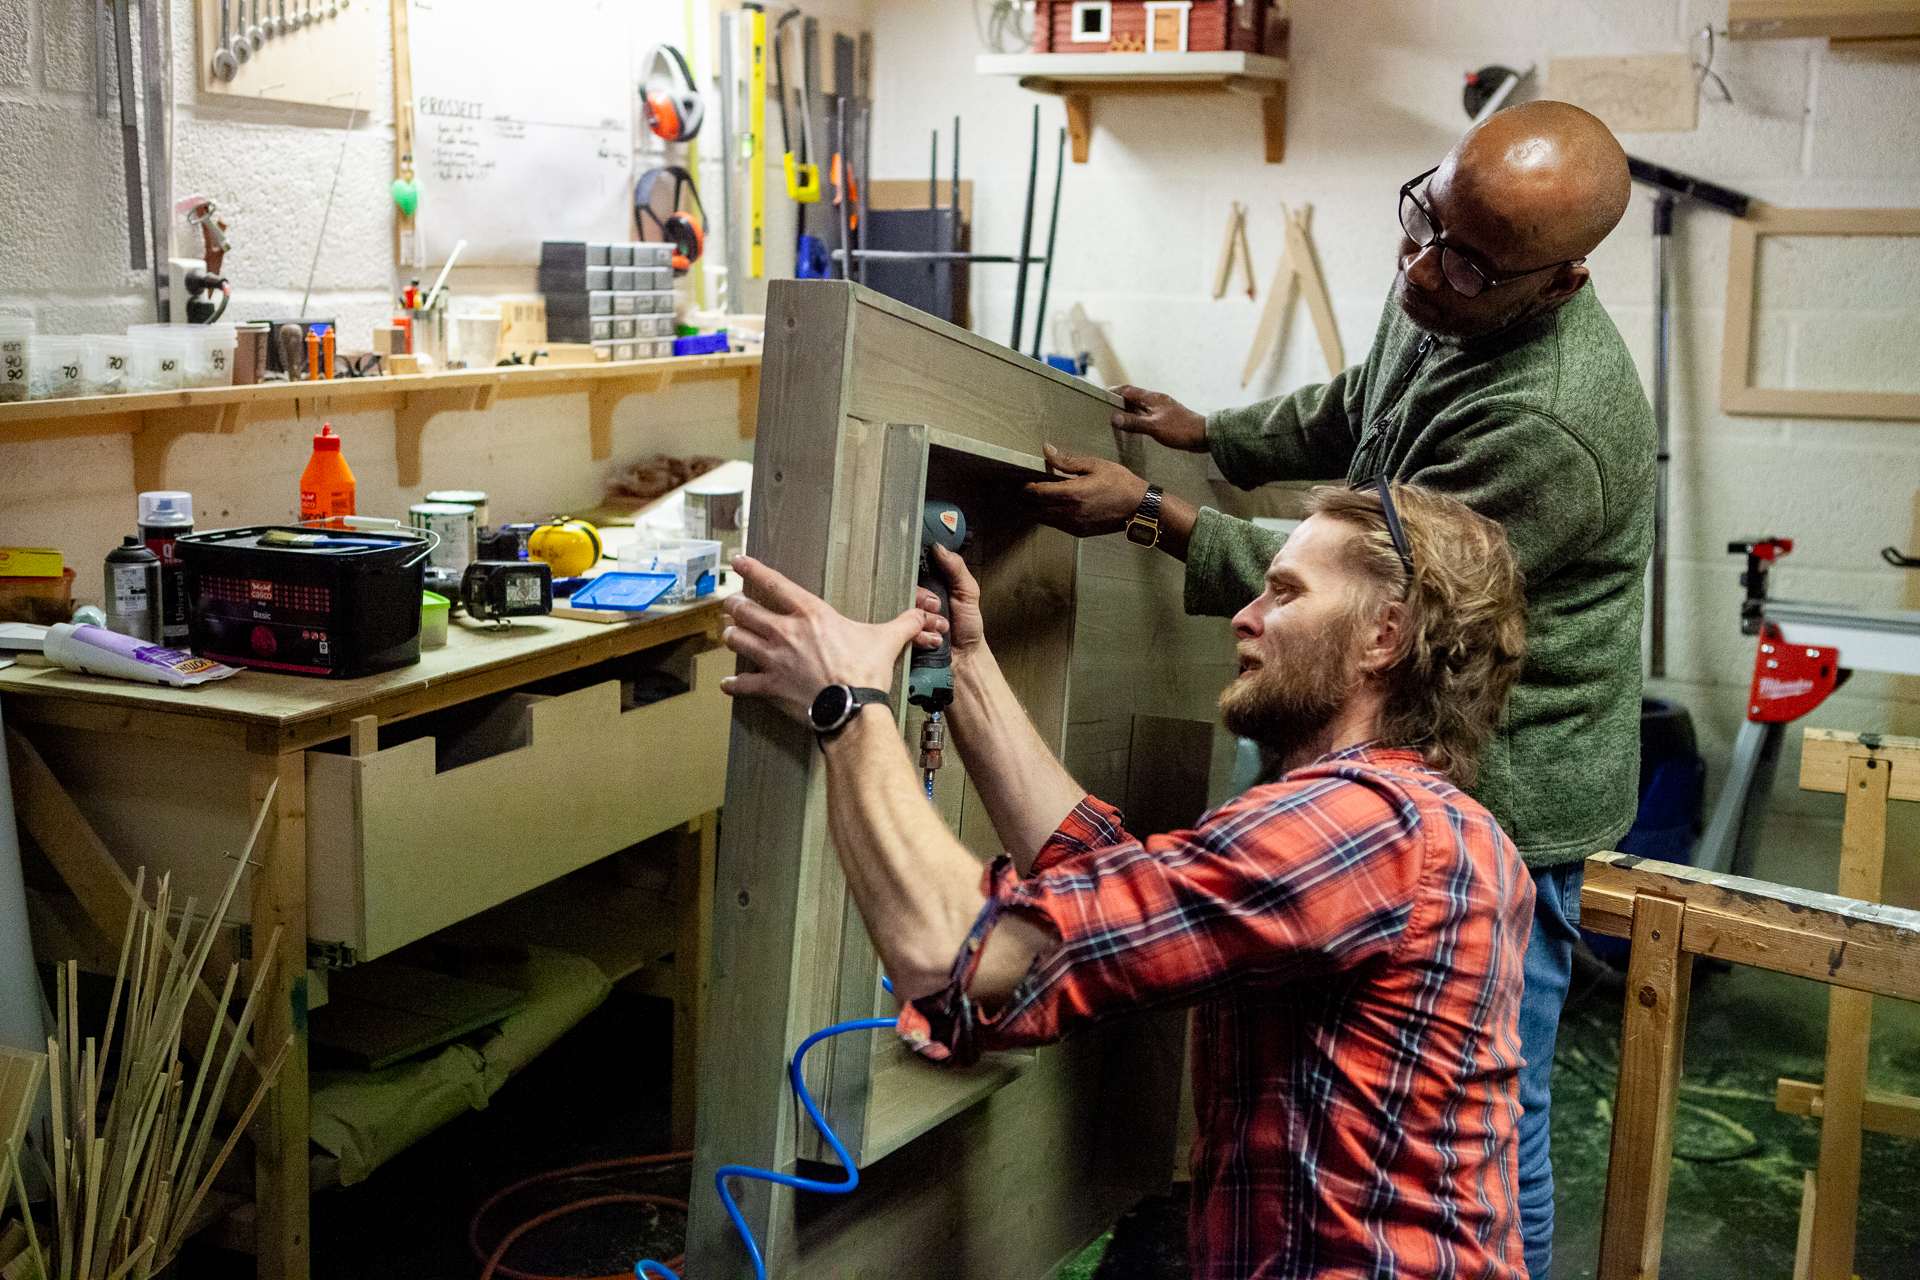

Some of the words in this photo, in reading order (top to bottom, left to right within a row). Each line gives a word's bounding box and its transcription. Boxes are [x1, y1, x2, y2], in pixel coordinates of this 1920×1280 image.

[109, 356, 123, 370] 70
[161, 360, 175, 371] 60
[7, 369, 23, 380] 90
[63, 366, 78, 379] 70
[253, 610, 272, 620] Basic
